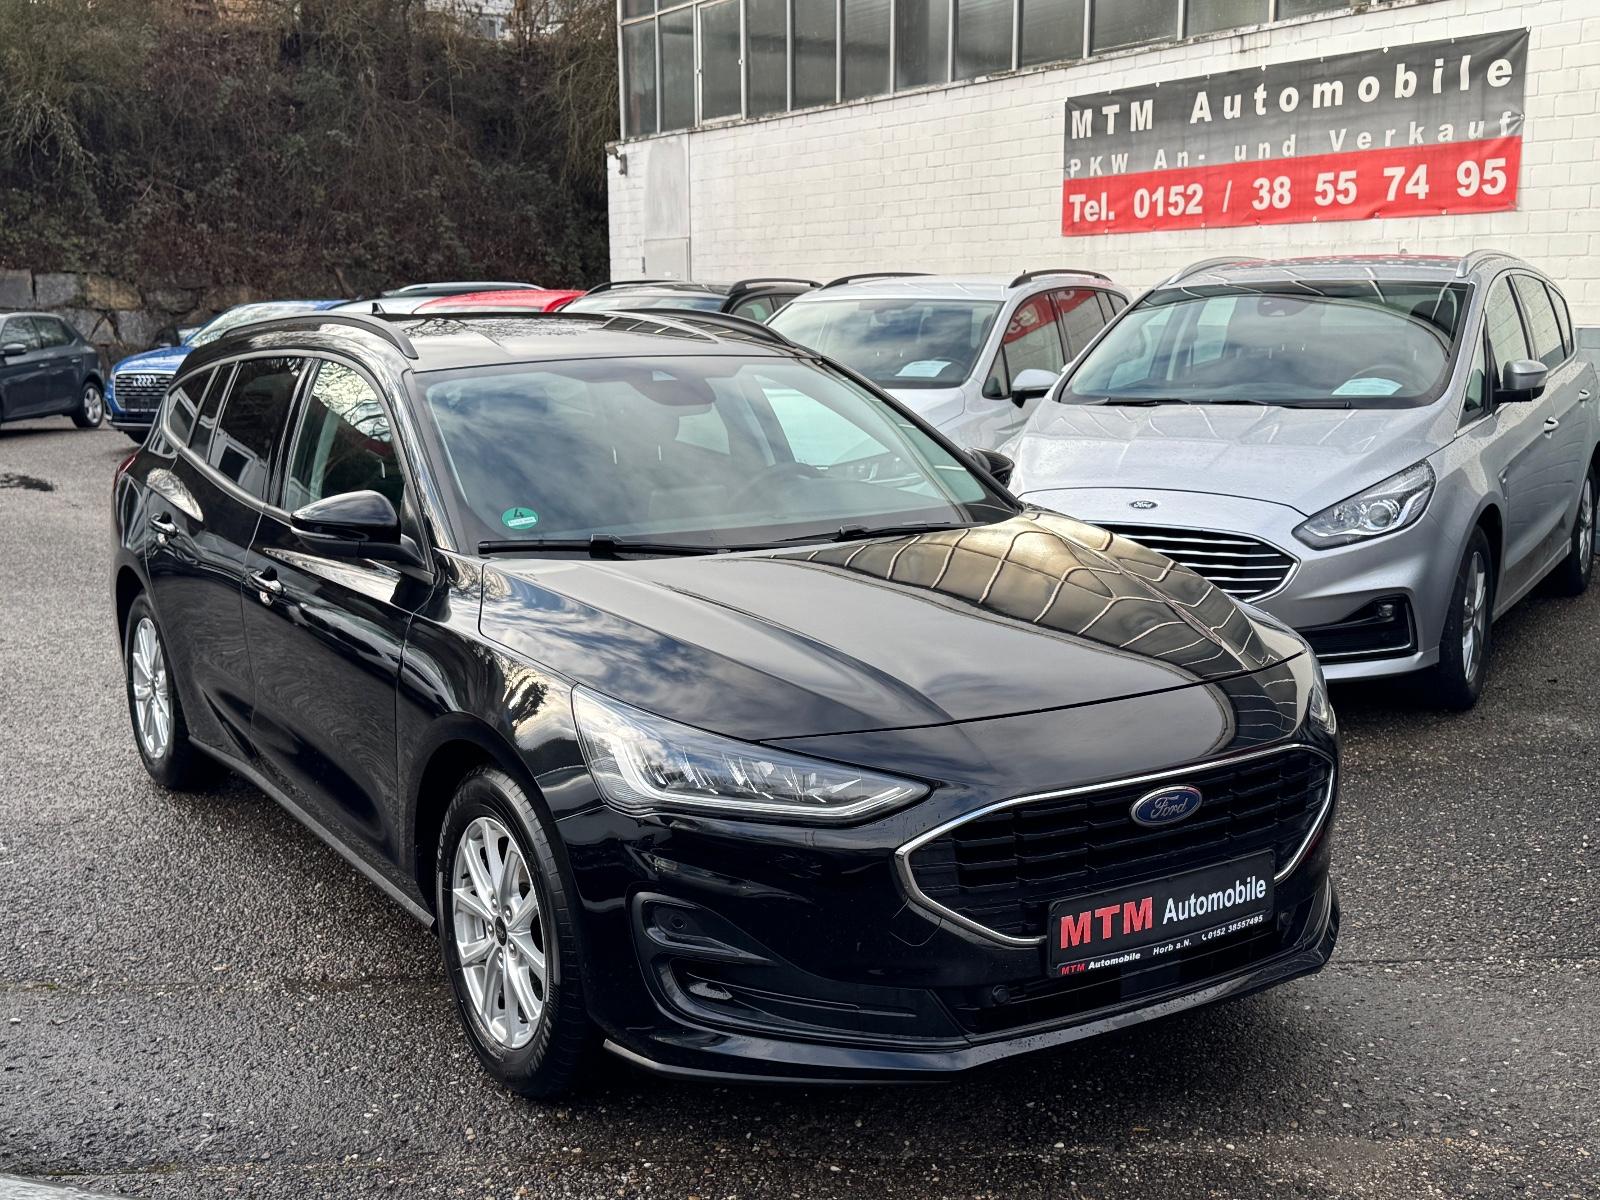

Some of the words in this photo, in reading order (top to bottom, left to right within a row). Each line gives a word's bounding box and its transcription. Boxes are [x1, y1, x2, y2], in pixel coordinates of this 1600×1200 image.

[1071, 99, 1154, 139] MTM
[1189, 54, 1513, 124] Automobile
[1069, 152, 1129, 178] PKW
[1153, 148, 1206, 170] An-
[1234, 133, 1297, 161] und
[1328, 110, 1512, 152] Verkauf
[1068, 191, 1116, 223] Tel.
[1133, 182, 1204, 219] 0152
[1222, 179, 1233, 213] /
[1251, 175, 1292, 211] 38
[1313, 170, 1358, 207] 55
[1383, 163, 1430, 202] 74
[1456, 157, 1508, 198] 95
[1150, 794, 1189, 820] Ford
[1060, 896, 1153, 950] MTM
[1162, 875, 1267, 925] Automobile
[1061, 963, 1086, 976] MTM
[1087, 952, 1141, 971] Automobile
[1152, 943, 1174, 956] Horb
[1207, 927, 1226, 940] 0152
[1227, 914, 1264, 933] 38557495
